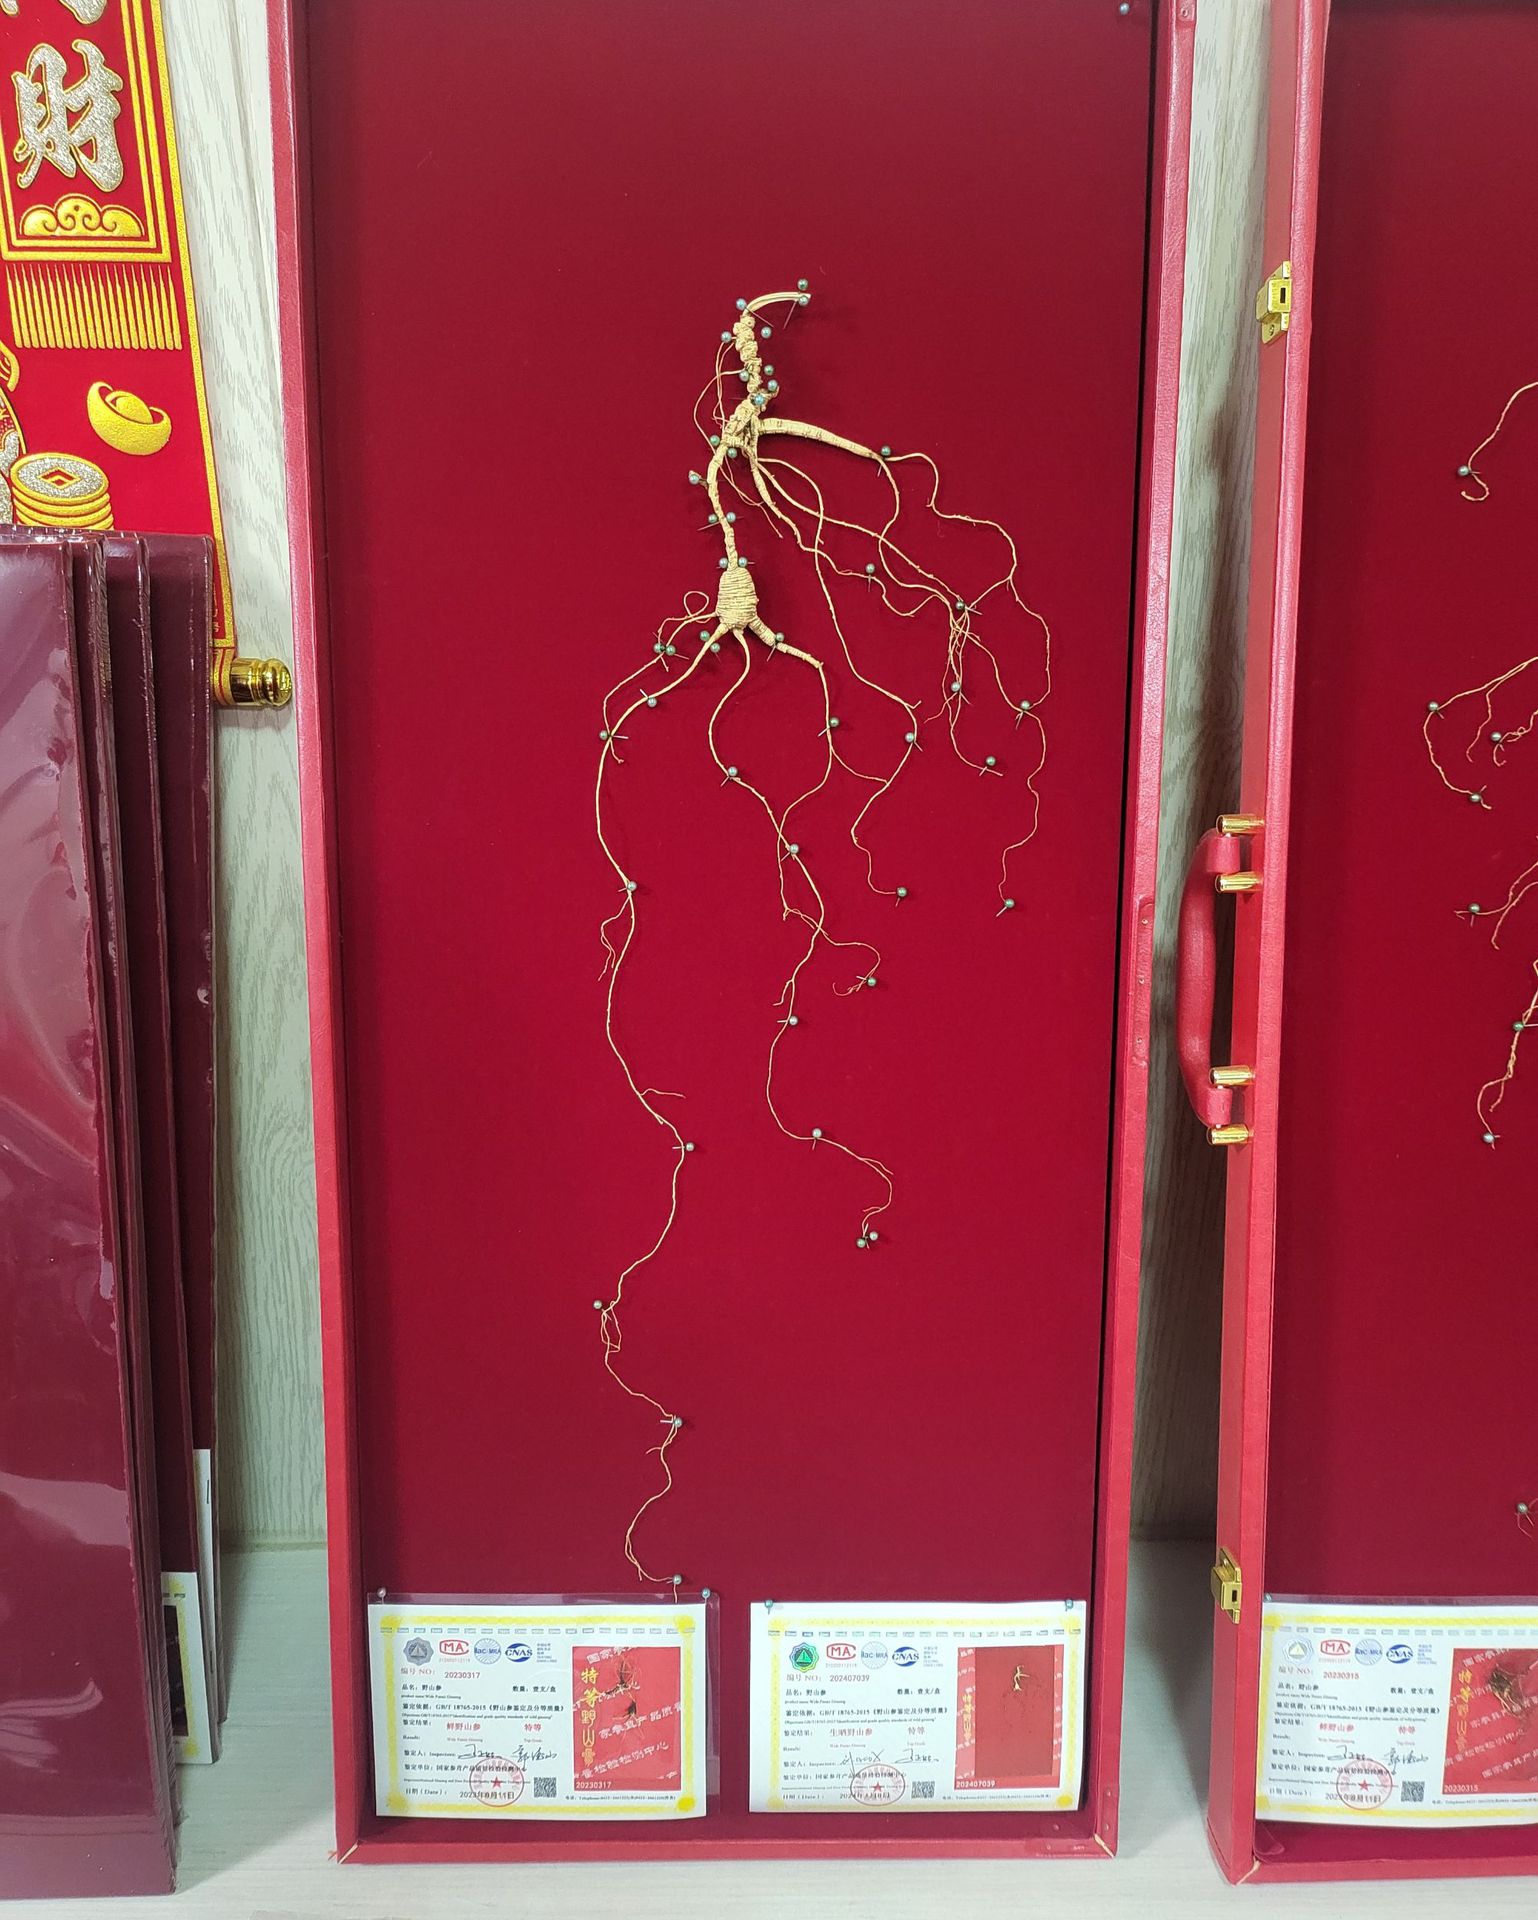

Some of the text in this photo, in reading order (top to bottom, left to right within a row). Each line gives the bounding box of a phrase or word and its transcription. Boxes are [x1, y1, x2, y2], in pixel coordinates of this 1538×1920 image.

[11, 39, 123, 191] 財
[505, 1649, 533, 1657] CNAS
[892, 1653, 920, 1661] CNAS
[444, 1671, 480, 1679] 20230317
[1323, 1671, 1360, 1680] 20230315
[575, 1781, 612, 1789] 20230317
[955, 1780, 996, 1788] 202407039
[1444, 1784, 1479, 1793] 20230315
